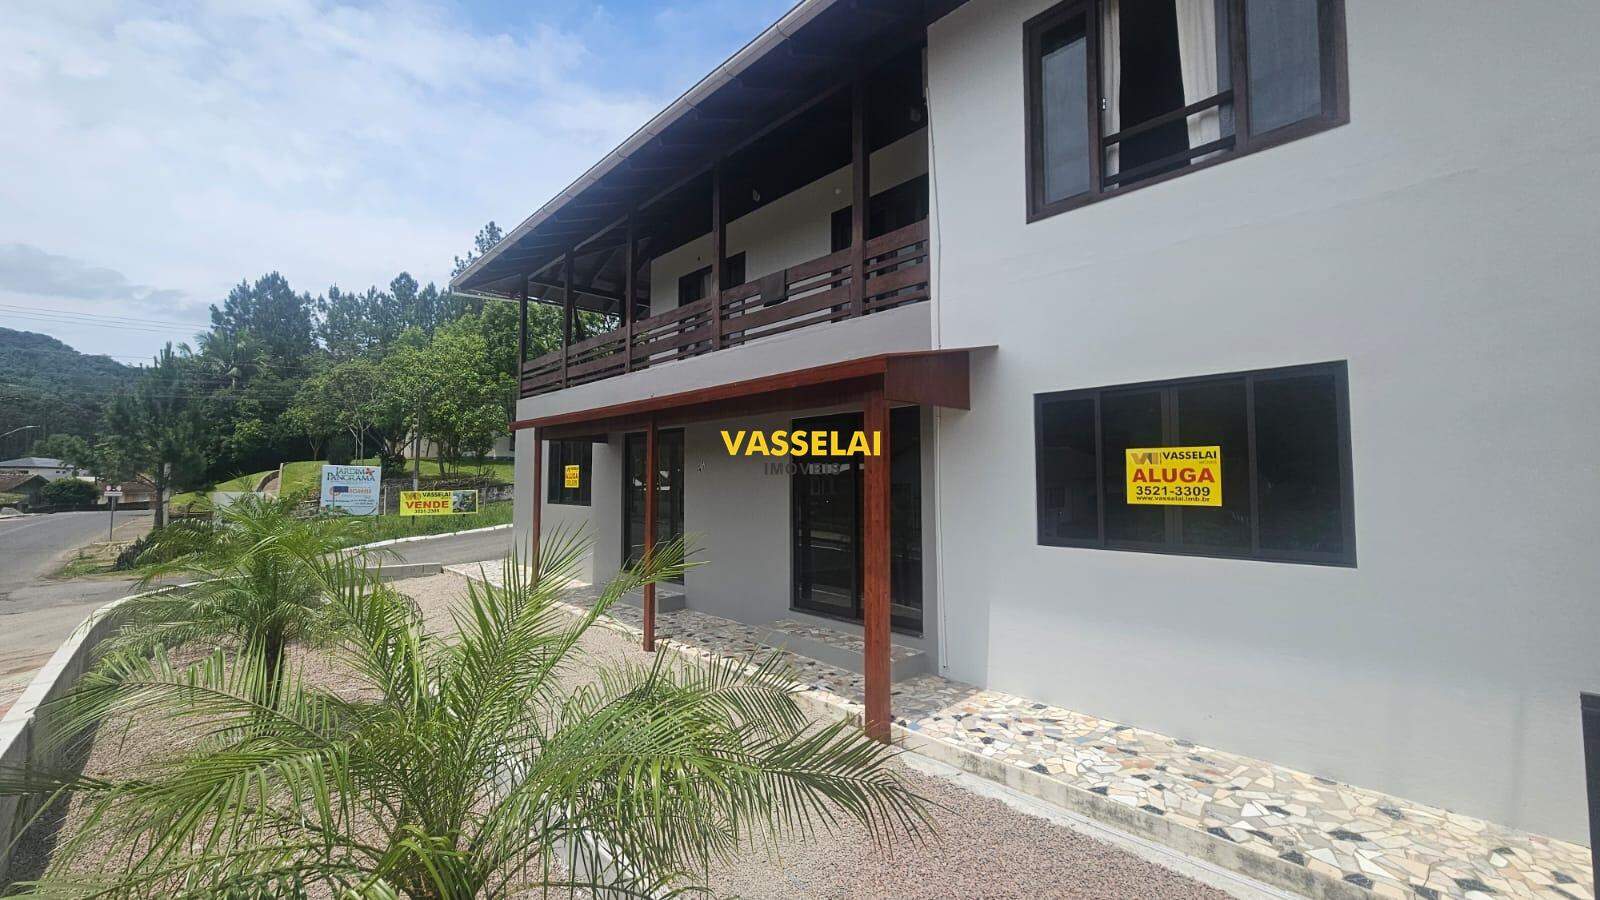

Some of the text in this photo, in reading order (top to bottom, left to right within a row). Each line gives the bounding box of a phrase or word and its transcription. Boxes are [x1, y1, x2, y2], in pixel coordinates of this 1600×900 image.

[1162, 451, 1217, 460] VASSELAI
[1132, 467, 1215, 483] ALUGA
[1136, 486, 1211, 497] 3521-3309
[405, 500, 449, 509] VENDE
